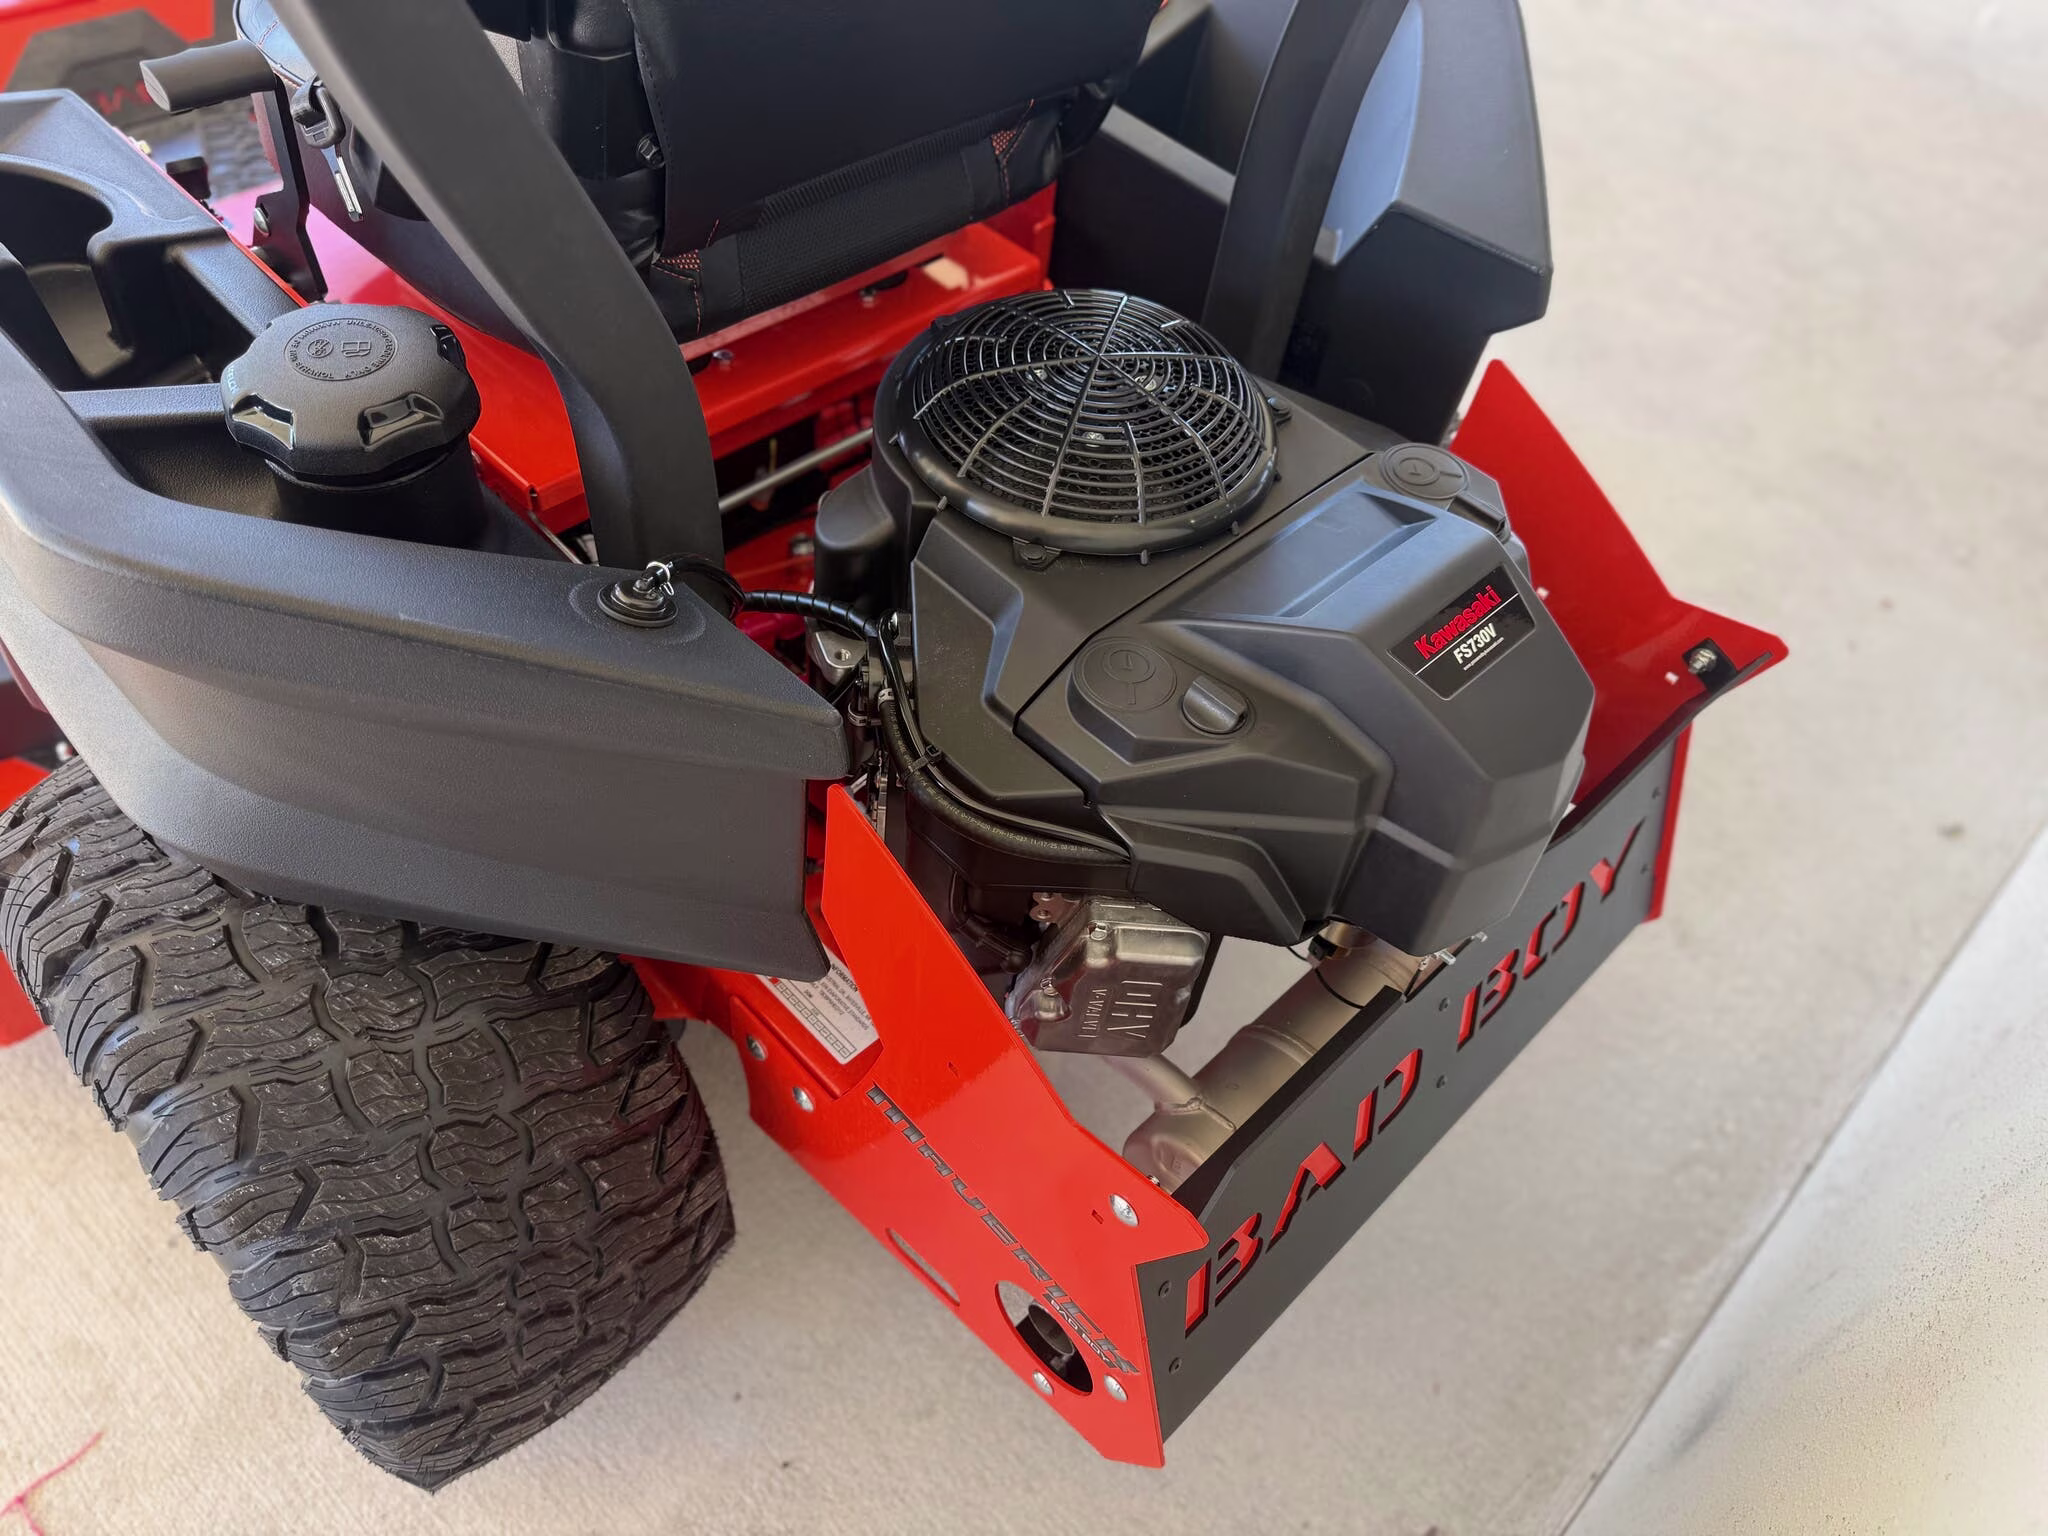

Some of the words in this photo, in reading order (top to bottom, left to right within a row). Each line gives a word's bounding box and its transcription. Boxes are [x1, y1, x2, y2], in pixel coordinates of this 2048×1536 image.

[1413, 584, 1502, 660] Kawasaki
[1452, 622, 1498, 664] FS730V
[1184, 1047, 1424, 1339] BAD
[1456, 816, 1646, 1051] BOY
